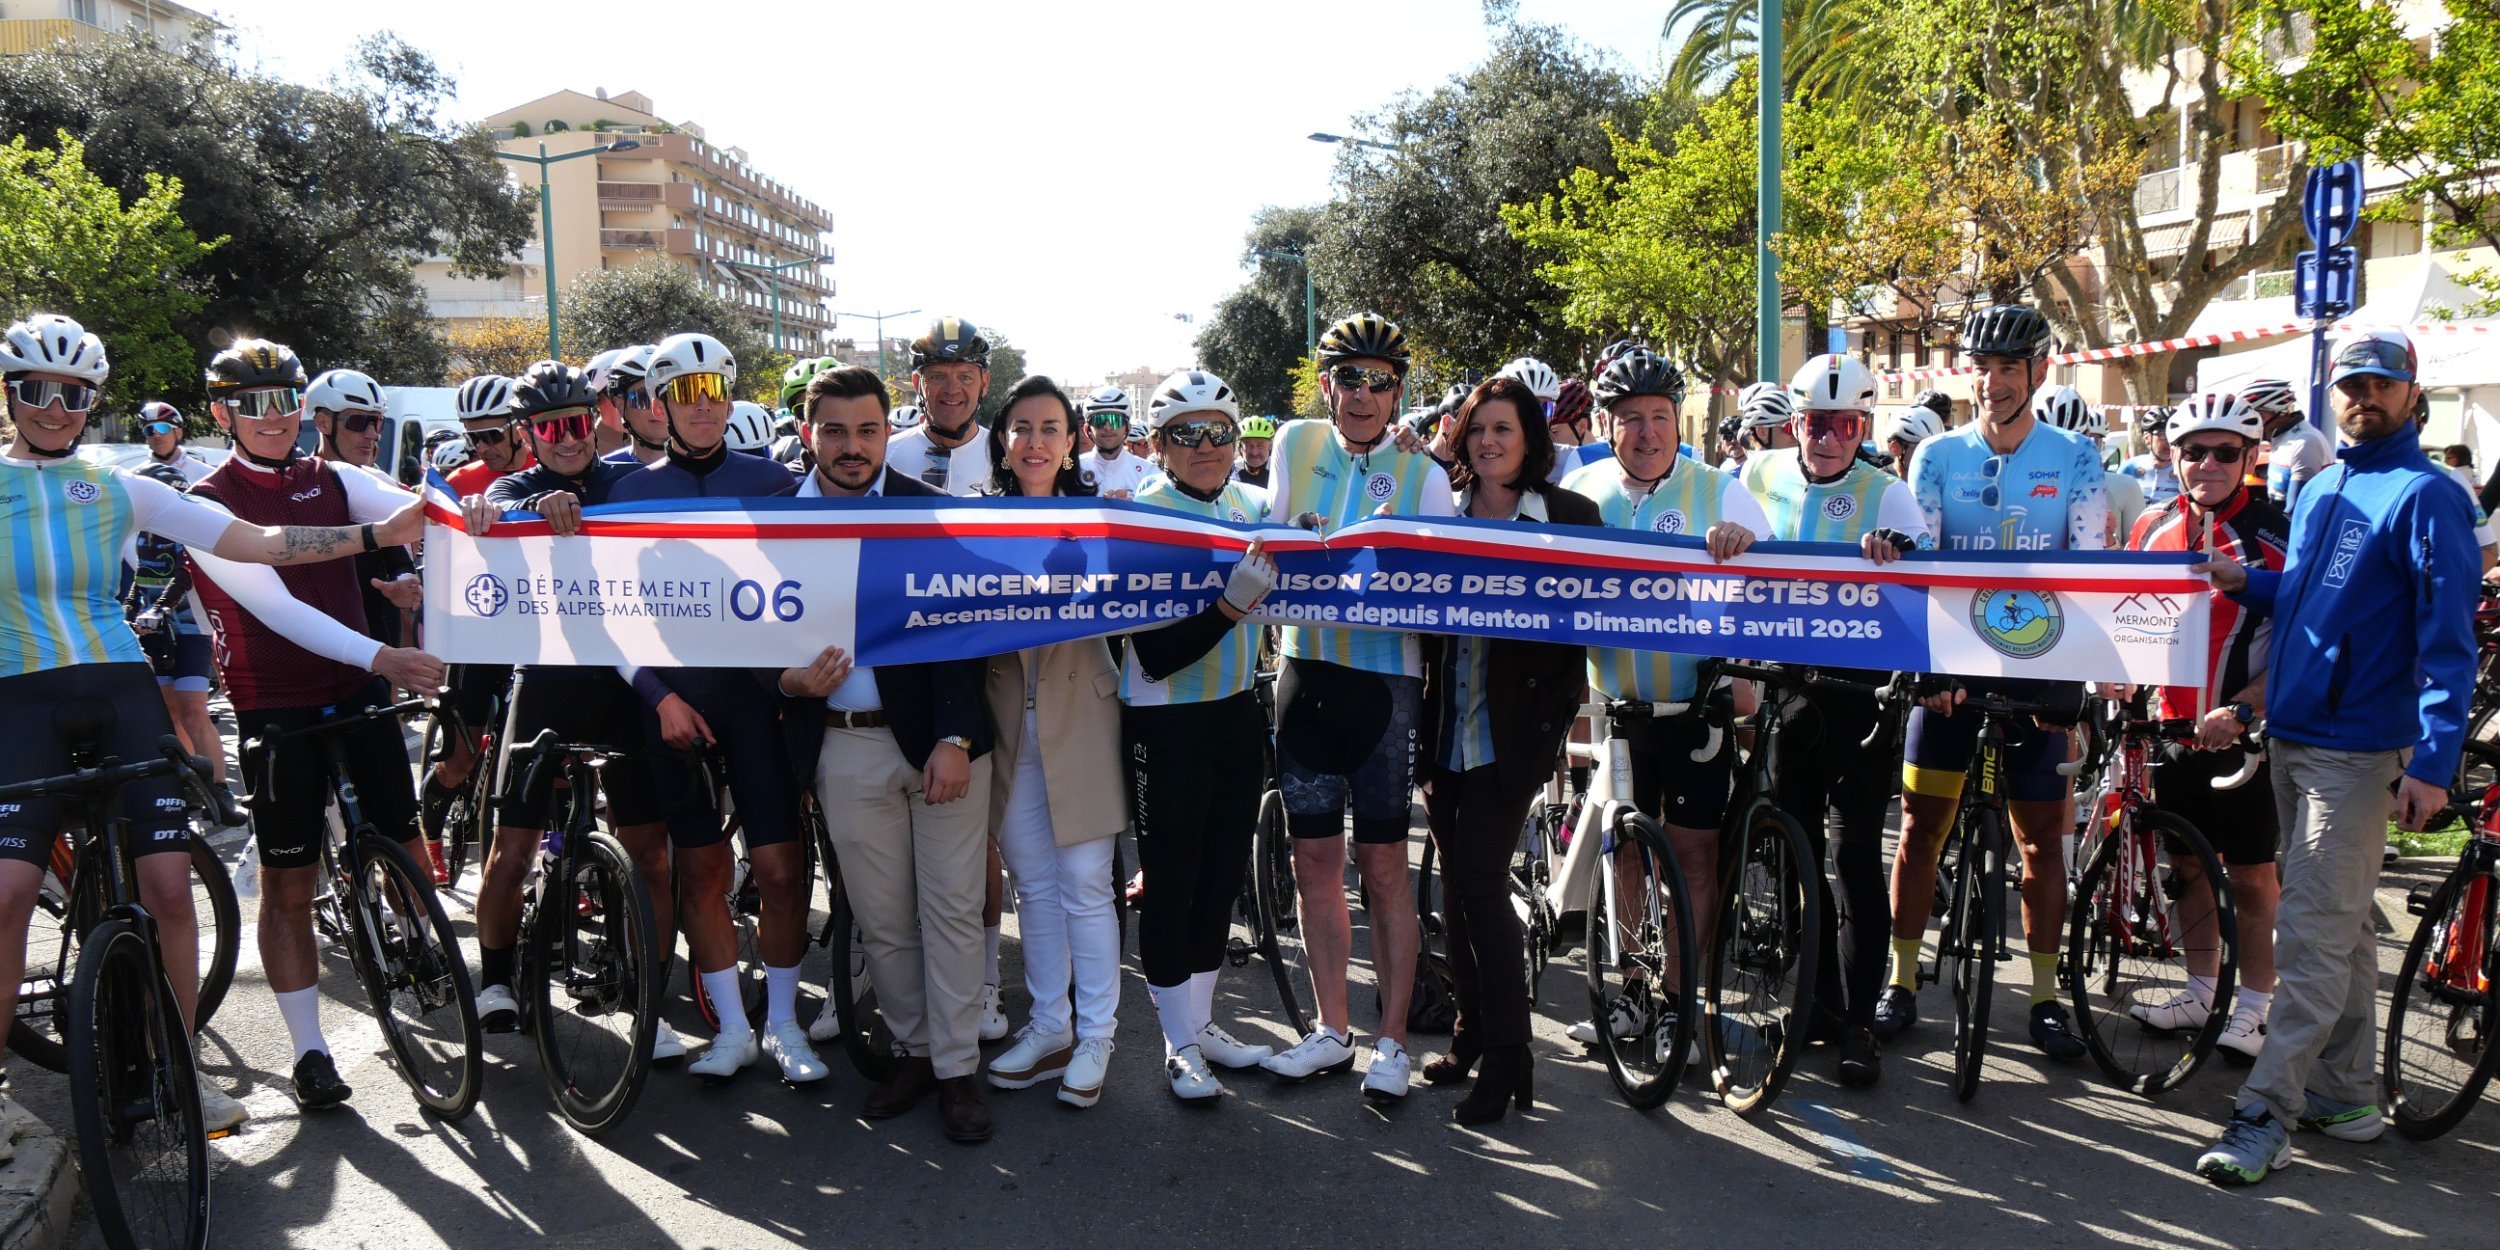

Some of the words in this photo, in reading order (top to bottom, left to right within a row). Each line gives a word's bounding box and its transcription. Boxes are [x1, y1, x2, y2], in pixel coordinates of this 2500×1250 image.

[2028, 470, 2060, 480] SOMAT
[1980, 526, 1992, 534] LA
[2257, 527, 2275, 541] Wind
[516, 575, 712, 598] DÉPARTEMENT
[905, 573, 1120, 598] LANCEMENT
[1127, 573, 1173, 592] DE
[1181, 570, 1225, 591] LA
[1369, 571, 1453, 594] 2026
[1460, 575, 1527, 596] DES
[1534, 577, 1622, 599] COLS
[1629, 577, 1829, 606] CONNECTÉS
[1837, 583, 1880, 608] 06
[729, 579, 805, 622] 06
[518, 600, 549, 615] DES
[556, 601, 712, 618] ALPES-MARITIMES
[904, 604, 1052, 629] Ascension
[1058, 601, 1095, 620] du
[1101, 599, 1148, 619] Col
[1154, 599, 1189, 618] de
[1250, 601, 1340, 622] adone
[1345, 602, 1439, 626] depuis
[1446, 606, 1550, 630] Menton
[1574, 611, 1713, 637] Dimanche
[1718, 616, 1736, 636] 5
[1742, 617, 1804, 638] avril
[1810, 619, 1883, 640] 2026
[2115, 615, 2179, 628] MERMONTS
[2113, 634, 2179, 646] ORGANISATION
[153, 829, 179, 840] DT
